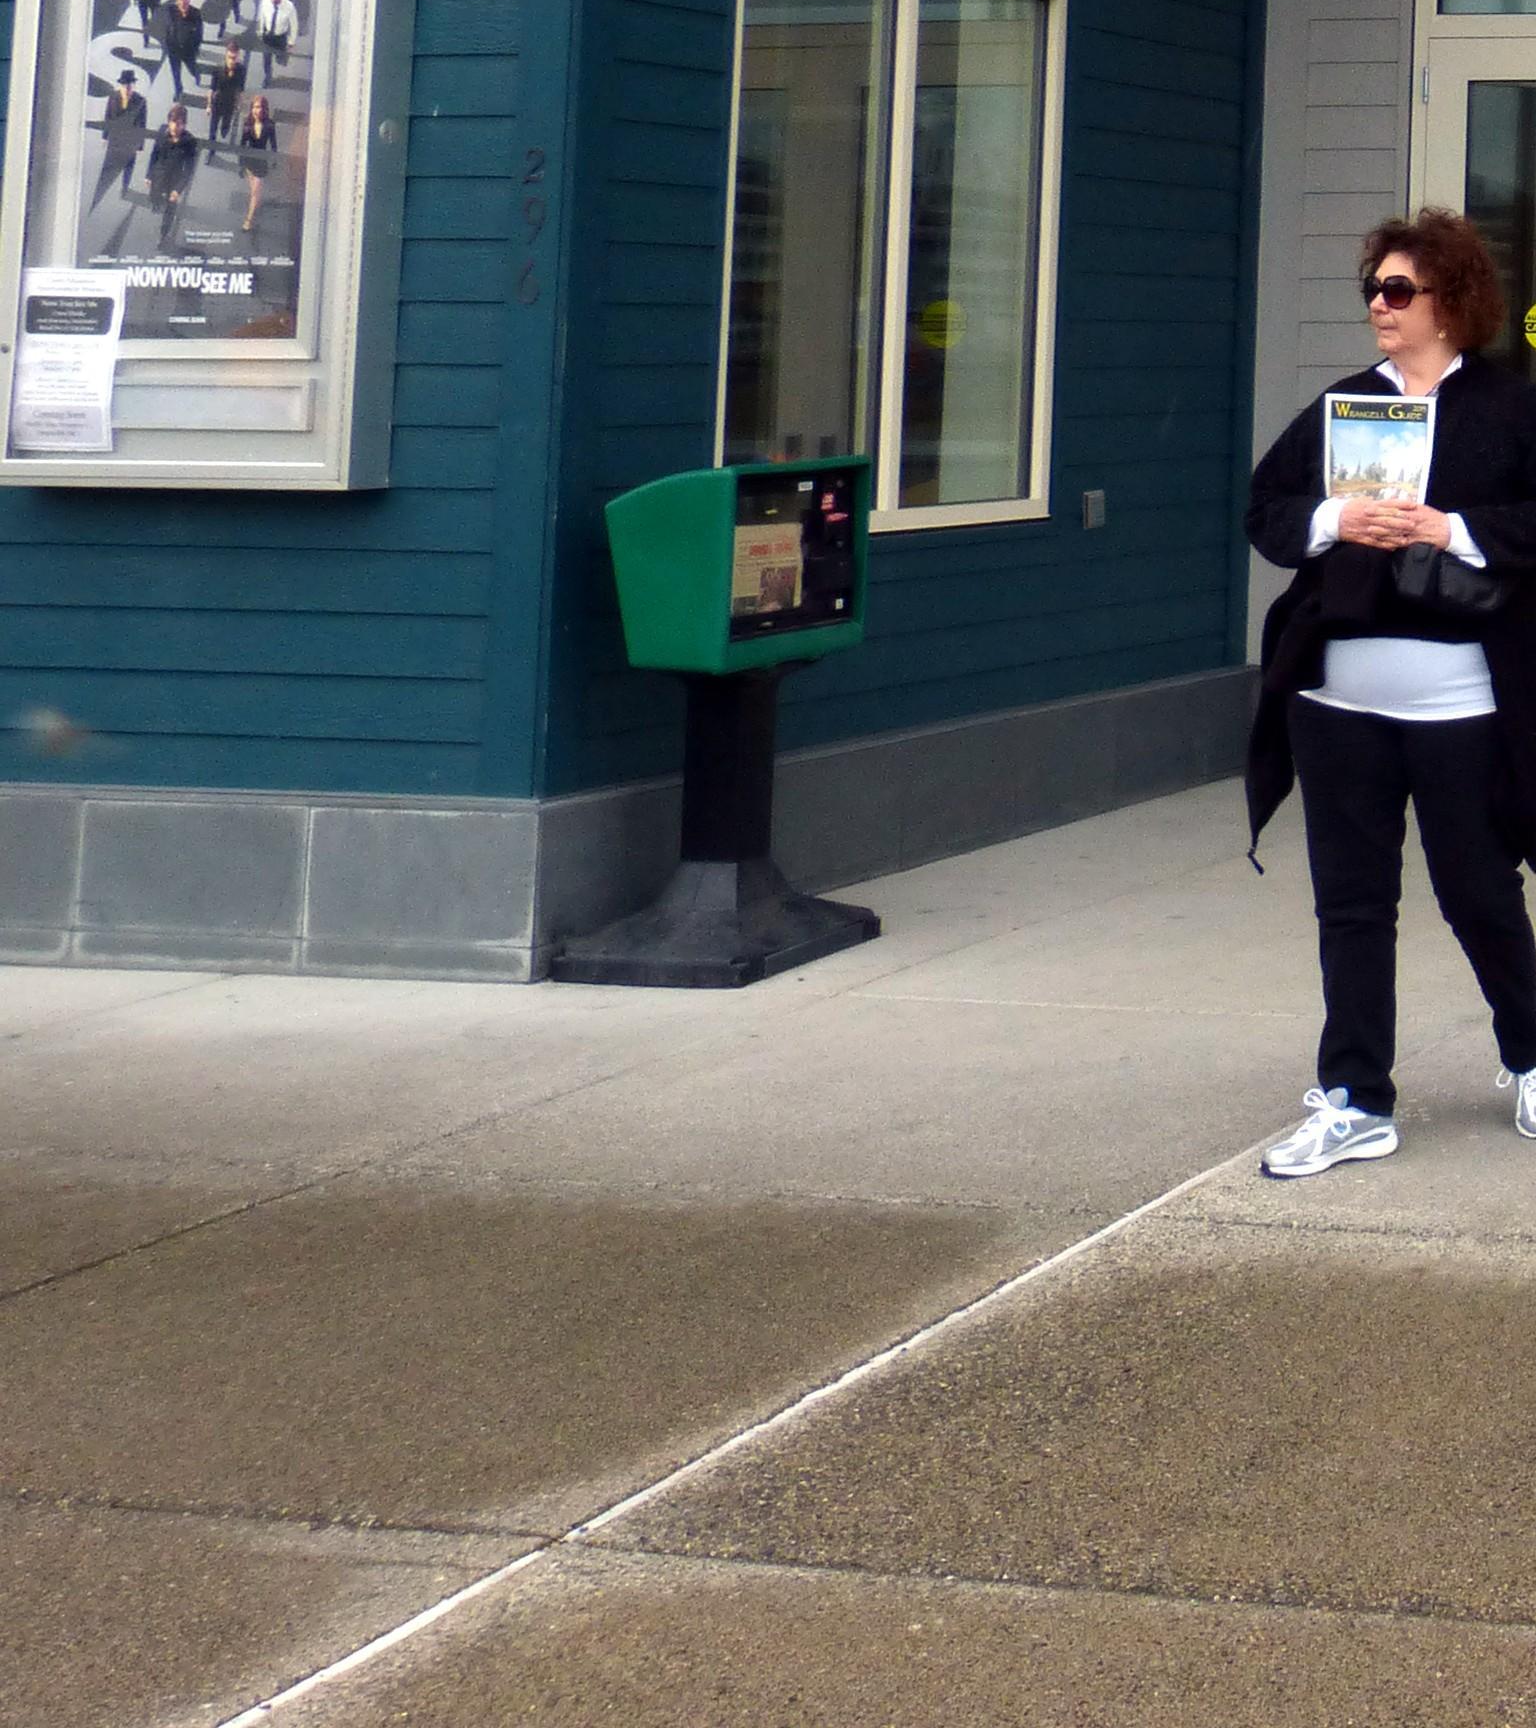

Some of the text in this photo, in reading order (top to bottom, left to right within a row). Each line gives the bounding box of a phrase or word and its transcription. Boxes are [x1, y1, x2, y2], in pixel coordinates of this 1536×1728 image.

[127, 266, 254, 294] NOW YOU SEE ME
